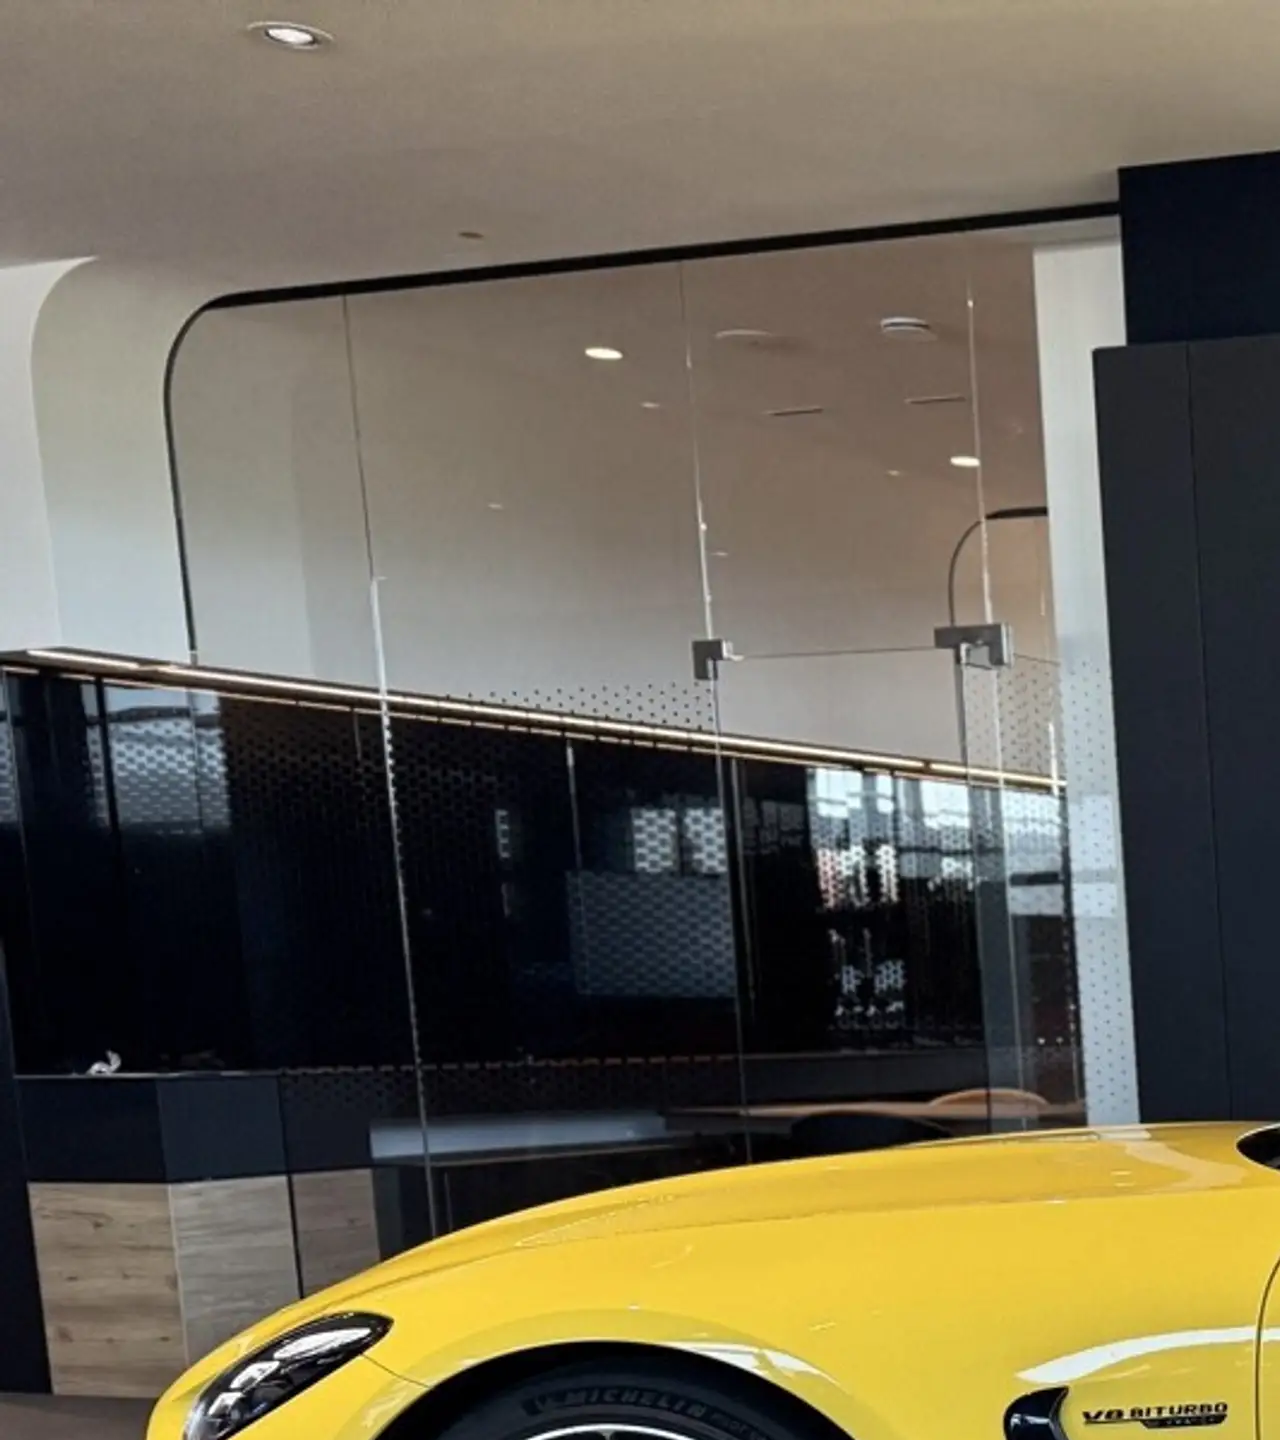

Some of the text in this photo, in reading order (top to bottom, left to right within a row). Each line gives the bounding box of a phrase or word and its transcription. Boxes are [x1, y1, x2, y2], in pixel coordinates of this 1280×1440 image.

[564, 1386, 707, 1419] MICHELIN
[1082, 1402, 1228, 1421] V8 BITURBO
